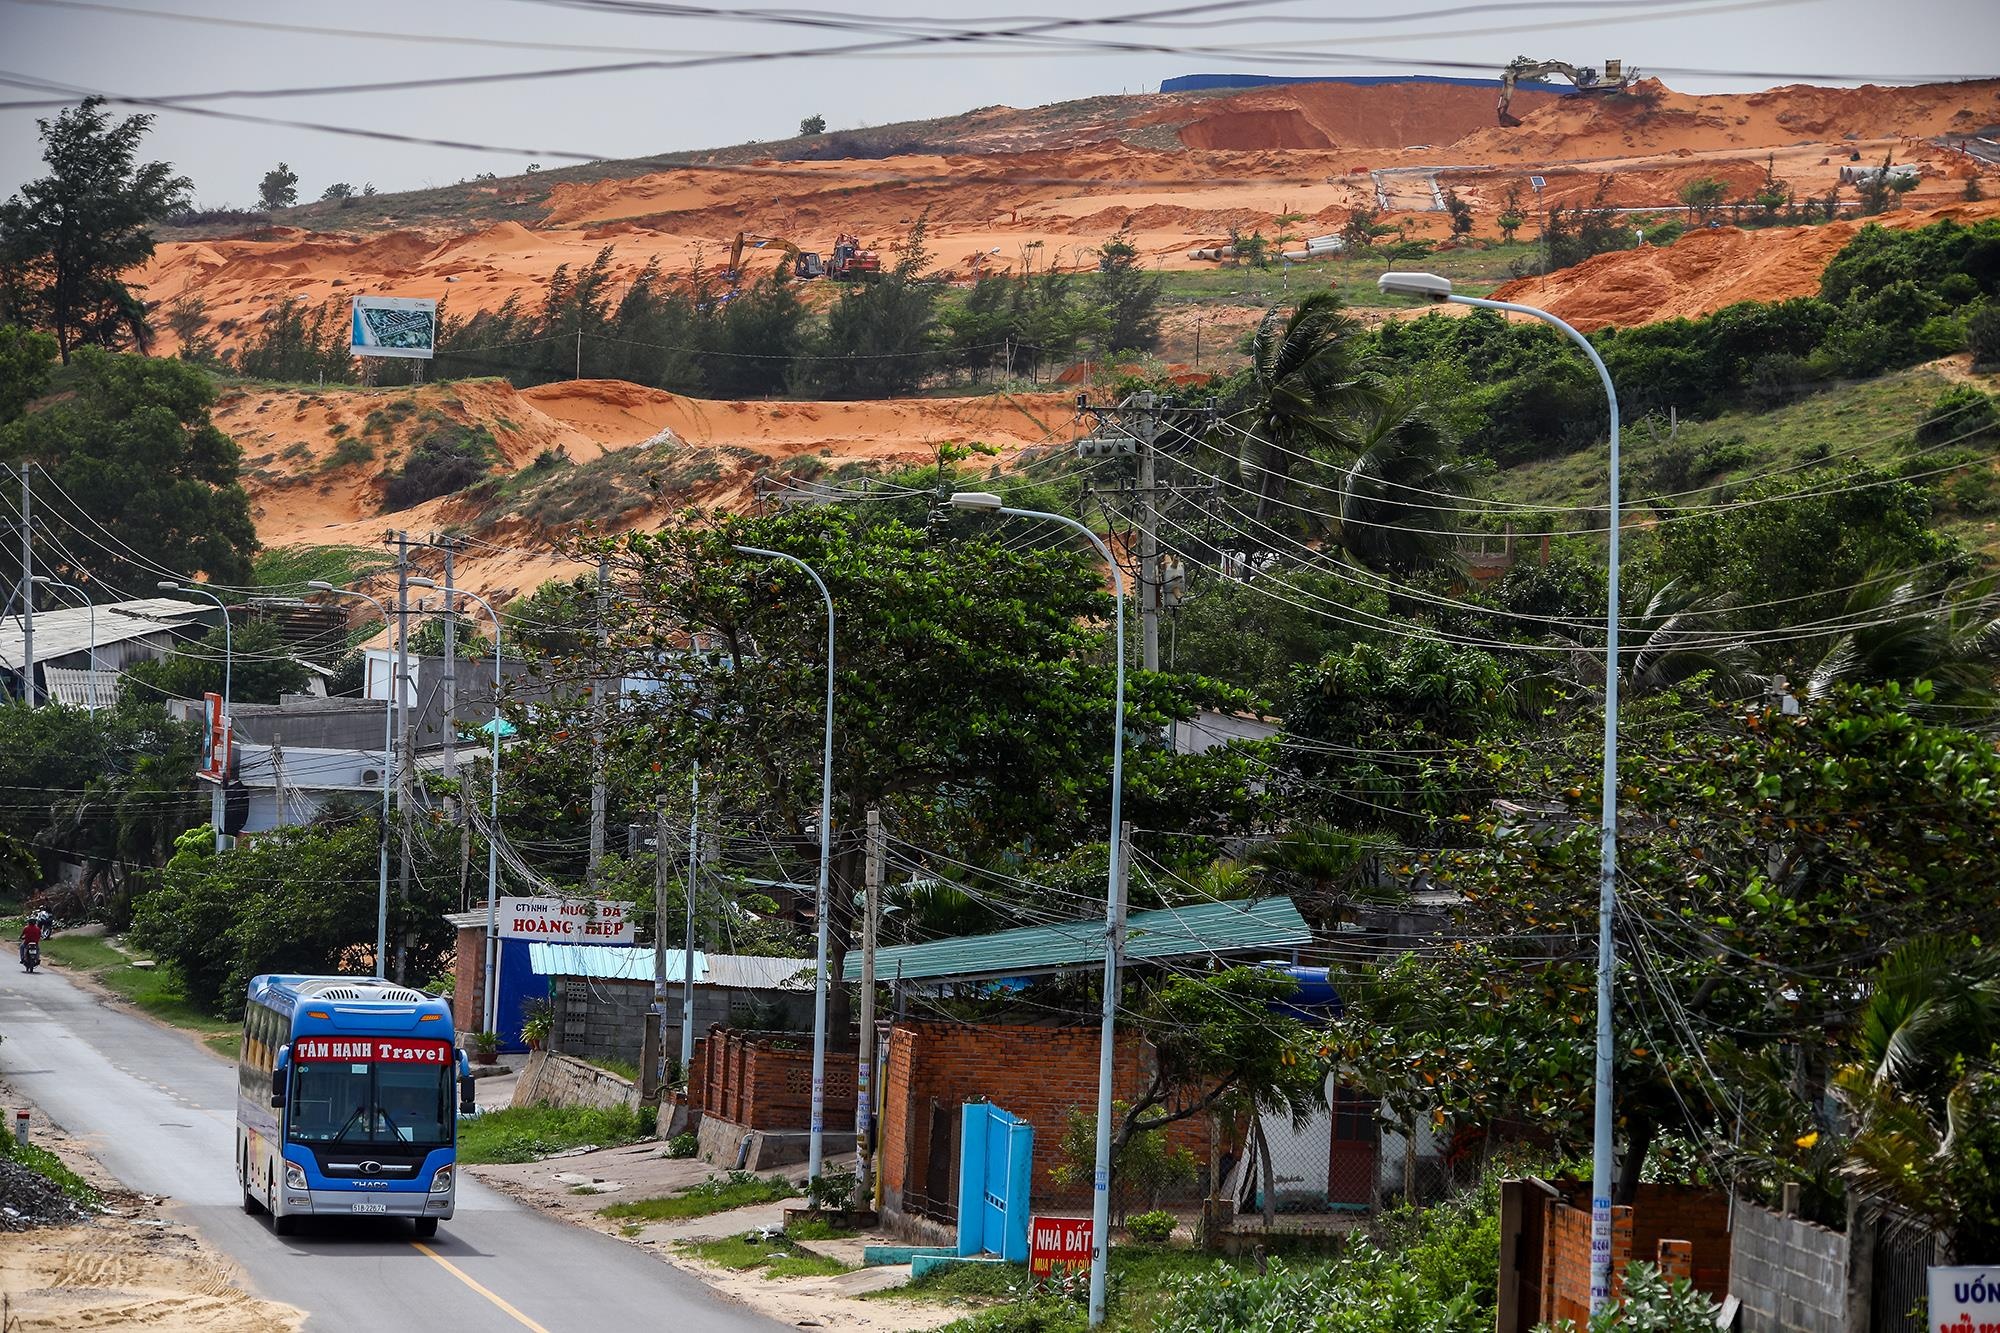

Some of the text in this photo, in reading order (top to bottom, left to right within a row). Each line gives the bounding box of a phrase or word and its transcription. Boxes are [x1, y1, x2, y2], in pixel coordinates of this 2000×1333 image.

[602, 905, 621, 918] ĐÁ
[513, 916, 573, 933] HOÀNG
[297, 1040, 445, 1061] TÂM HẠNH Travel
[1036, 1222, 1092, 1252] NHÀ ĐẤT
